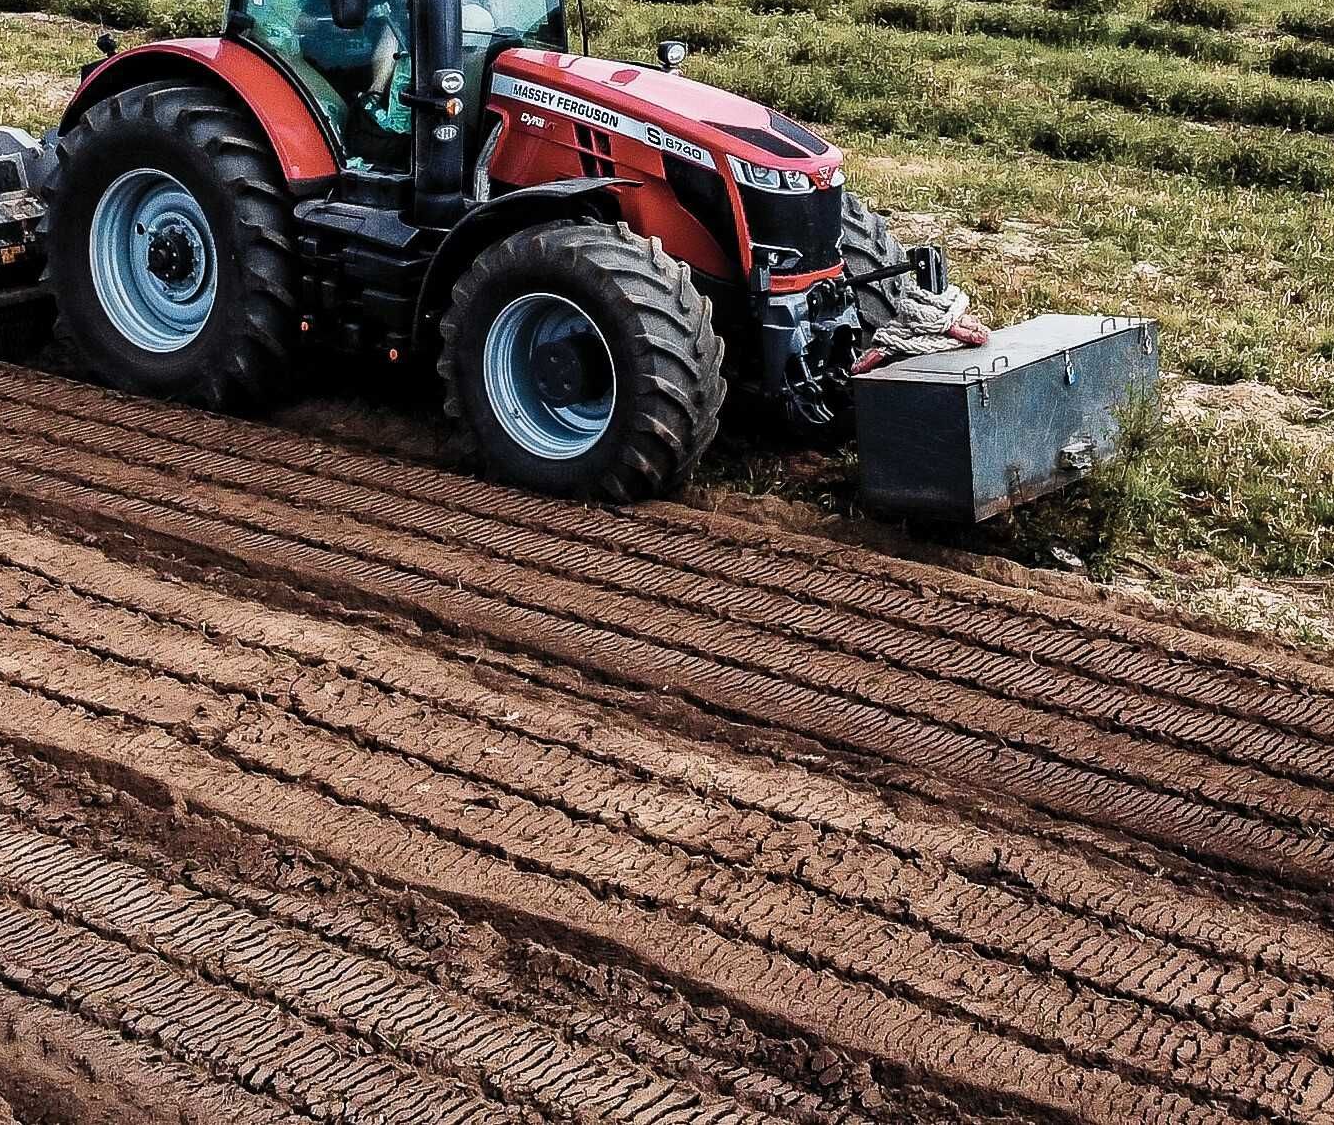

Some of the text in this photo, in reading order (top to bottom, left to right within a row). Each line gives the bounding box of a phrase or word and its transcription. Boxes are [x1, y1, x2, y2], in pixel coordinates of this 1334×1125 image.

[513, 83, 555, 106] MASSEY
[556, 96, 619, 128] FERGUSON
[647, 126, 662, 146] S
